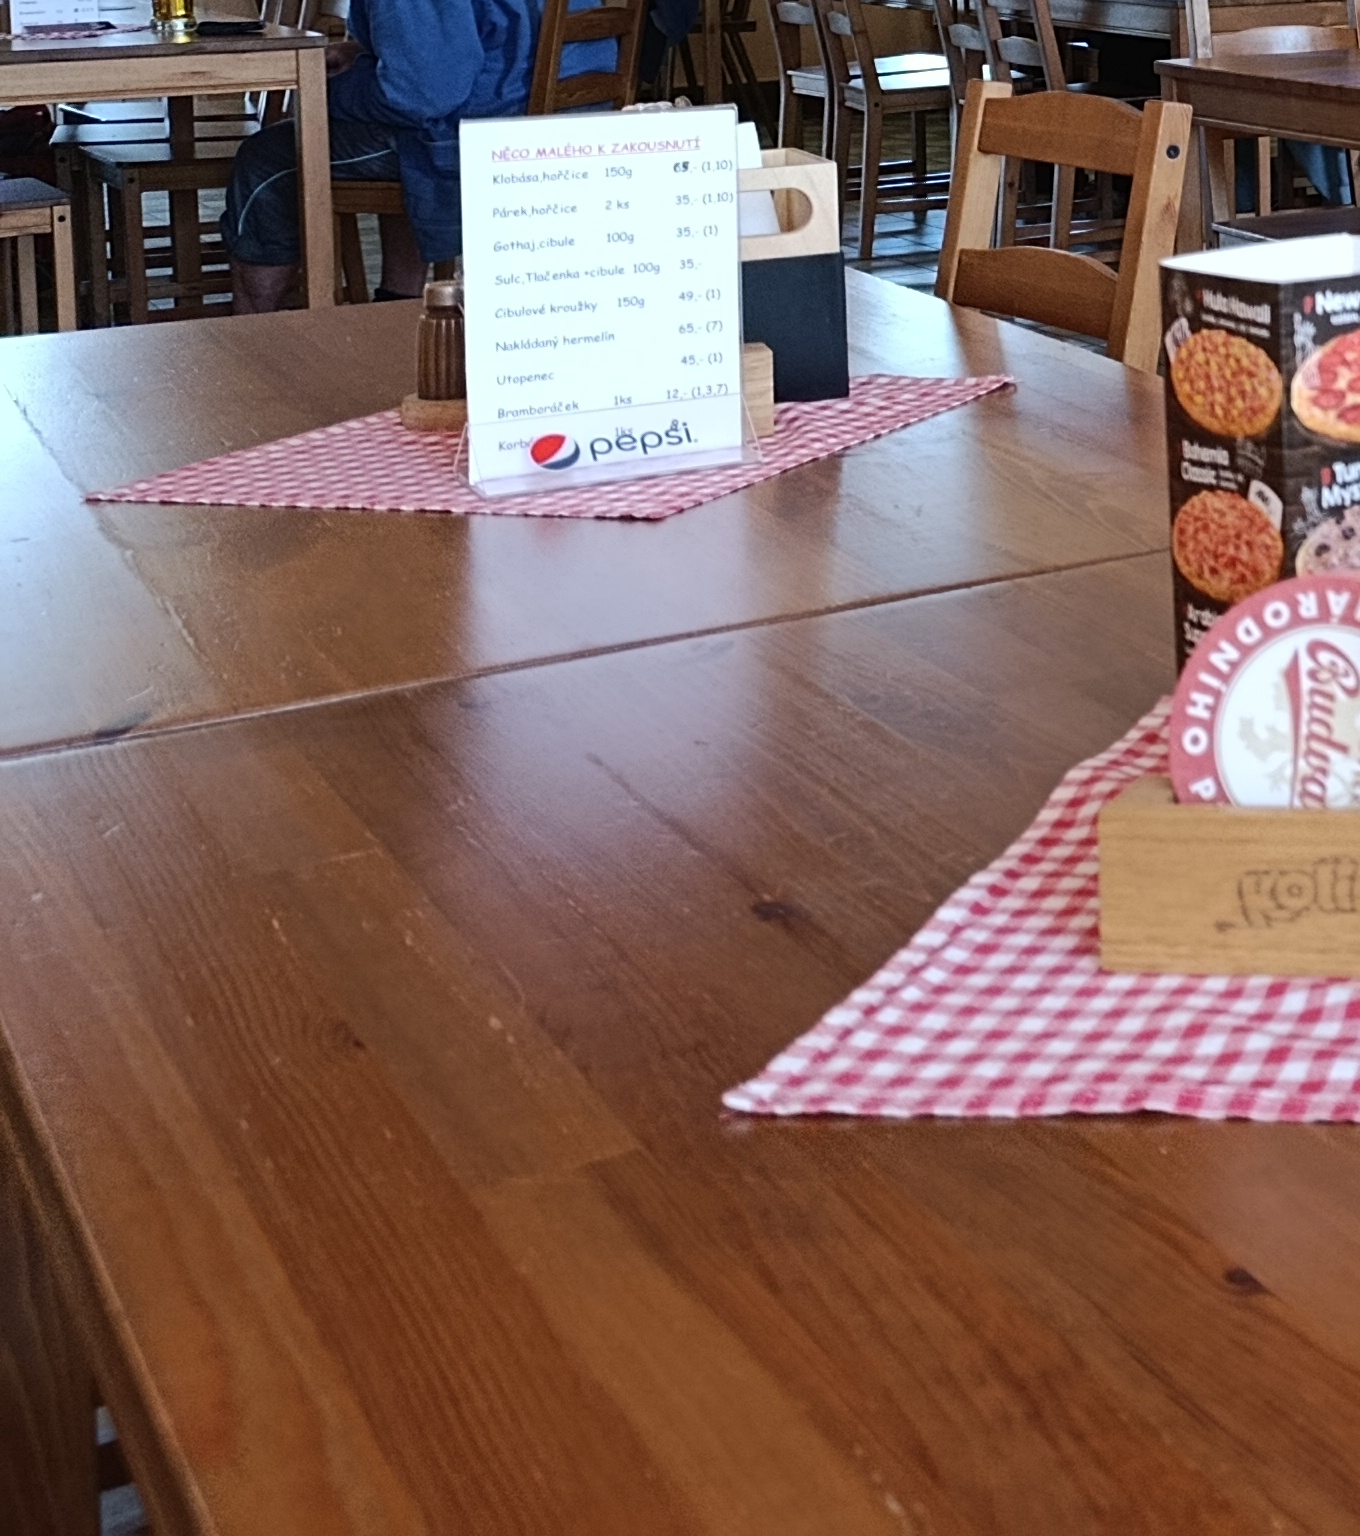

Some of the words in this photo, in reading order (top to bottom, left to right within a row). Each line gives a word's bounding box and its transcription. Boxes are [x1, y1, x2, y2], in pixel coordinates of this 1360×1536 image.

[491, 146, 530, 161] NĚCO
[536, 142, 593, 158] MALÉHO
[598, 144, 606, 155] K
[611, 135, 701, 154] ZAKOUSNUTÍ
[605, 166, 633, 179] 150g
[605, 200, 612, 211] 2
[616, 200, 630, 210] ks
[606, 231, 635, 245] 100g
[703, 224, 719, 238] (1)
[633, 262, 661, 275] 100g
[494, 304, 546, 319] Cibulové
[550, 300, 598, 314] kroužky
[617, 296, 645, 309] 150g
[705, 288, 721, 301] (1)
[495, 335, 559, 352] Nakládaný
[562, 331, 615, 345] hermelín
[706, 320, 723, 333] (7)
[496, 372, 555, 386] Utopenec
[707, 352, 723, 365] (1)
[497, 400, 579, 419] Bramboráček
[614, 395, 632, 406] 1ks
[590, 422, 693, 462] pepsi
